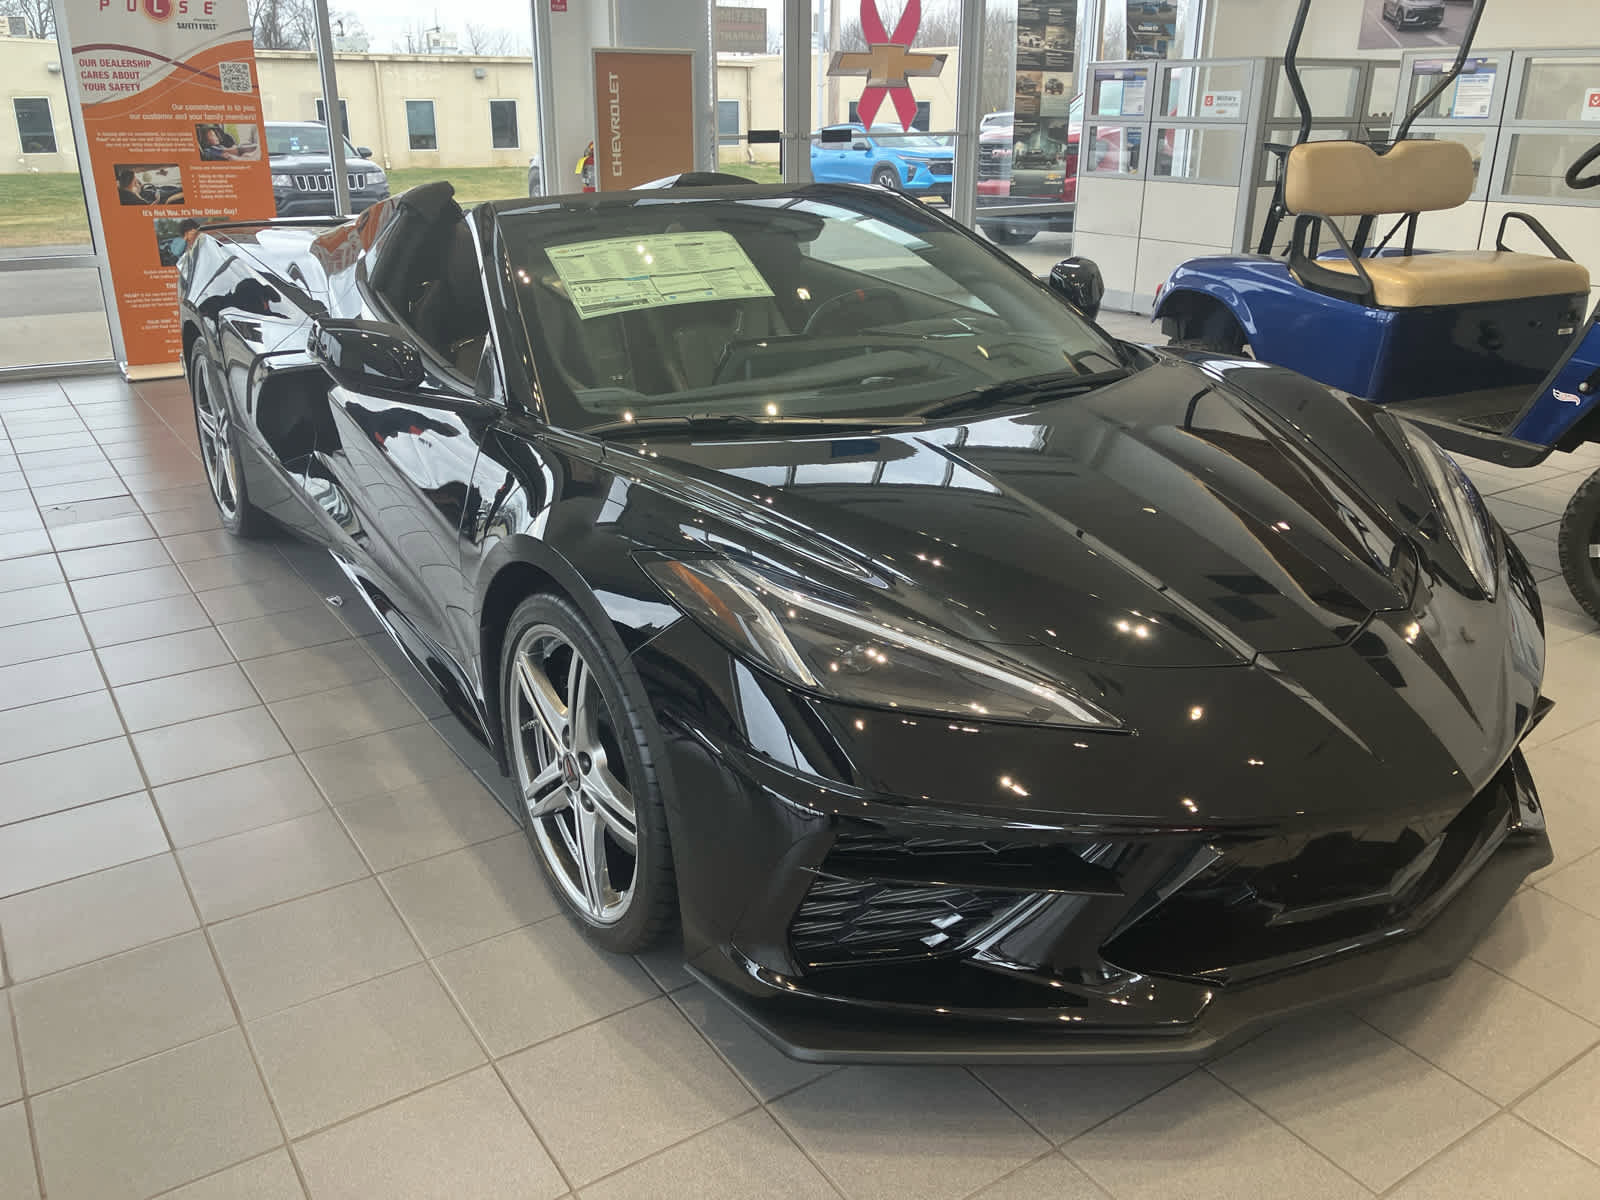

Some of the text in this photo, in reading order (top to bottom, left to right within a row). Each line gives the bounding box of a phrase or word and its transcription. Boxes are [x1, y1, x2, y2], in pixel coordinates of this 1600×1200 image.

[99, 0, 214, 15] PULSE
[79, 58, 152, 68] OUR DEALERSHIP
[80, 71, 140, 79] CARES ABOUT
[82, 82, 141, 91] YOUR SAFETY
[609, 72, 622, 176] CHEVROLET
[191, 208, 203, 216] The
